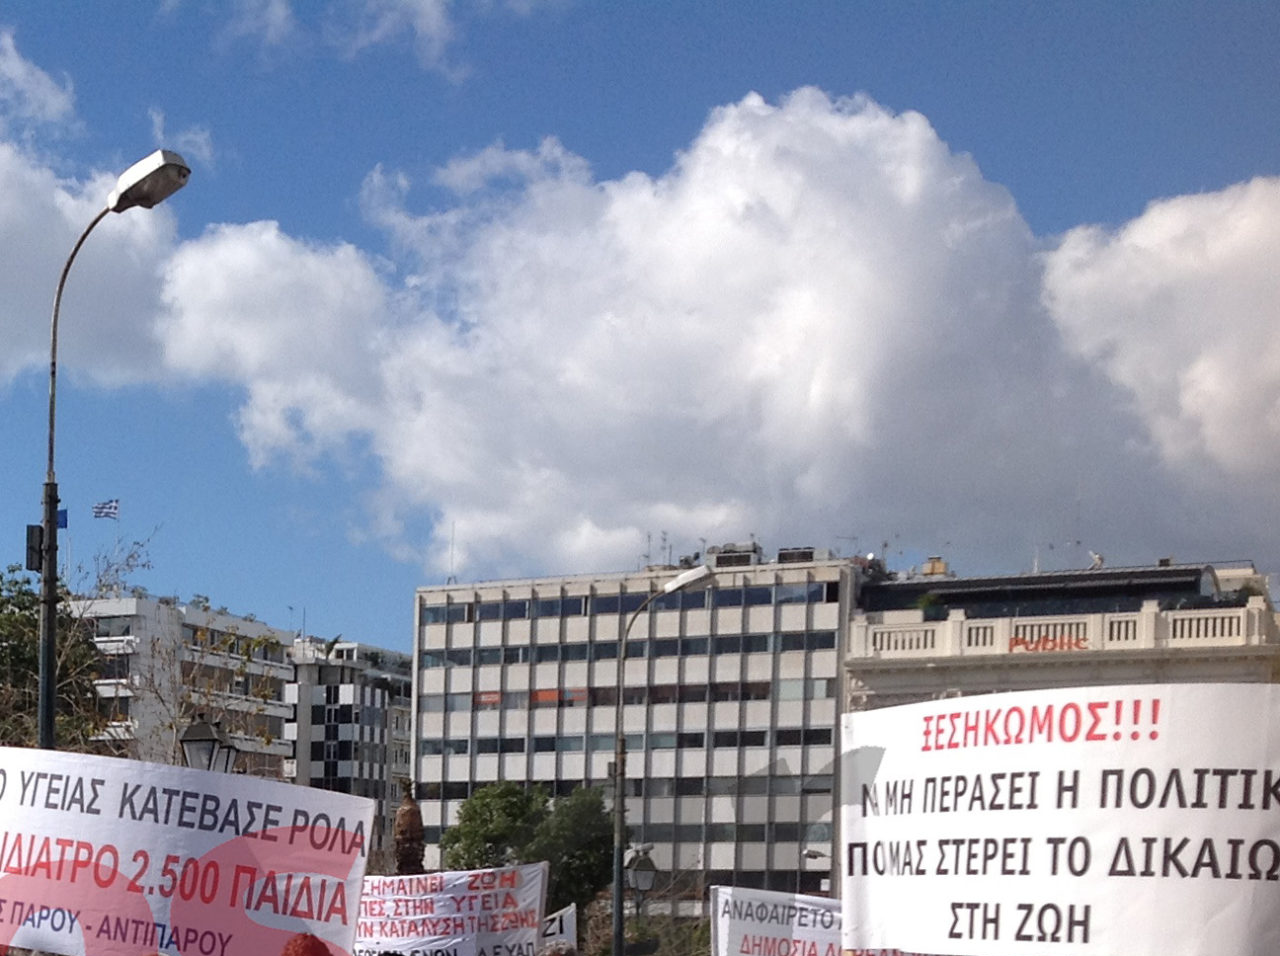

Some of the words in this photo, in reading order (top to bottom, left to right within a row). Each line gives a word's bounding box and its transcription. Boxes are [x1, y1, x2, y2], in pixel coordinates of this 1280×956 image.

[1009, 634, 1089, 653] Public
[921, 698, 1161, 752] ΞΕΣΗΚΩΜΟΣ!!!
[885, 779, 914, 816] ΜΗ
[922, 771, 1040, 814] ΠΕΡΑΣΕΙ
[1056, 770, 1080, 810] Η
[19, 771, 105, 815] ΥΓΕΙΑΣ
[119, 783, 283, 841] ΚΑΤΕΒΑΣΕ
[289, 808, 367, 858] ΡΟΛΑ
[935, 837, 1031, 877] ΣΤΕΡΕΙ
[1046, 836, 1091, 878] ΤΟ
[1109, 836, 1280, 881] ΔΙΚΑΙΩ
[127, 849, 220, 904] 2.500
[230, 863, 348, 926] ΠΑΙΔΙΑ
[467, 870, 518, 891] ΖΩΗ
[8, 901, 81, 936] ΠΑΡΟΥ
[393, 898, 434, 916] ΣΤΗΝ
[450, 892, 518, 912] ΥΓΕΙΑ
[721, 899, 834, 929] ΑΝΑΦΑΙΡΕΤΟ
[948, 902, 1000, 940] ΣΤΗ
[1014, 903, 1091, 943] ΖΩΗ
[379, 916, 465, 938] ΚΑΤΑΛΥΣΗ
